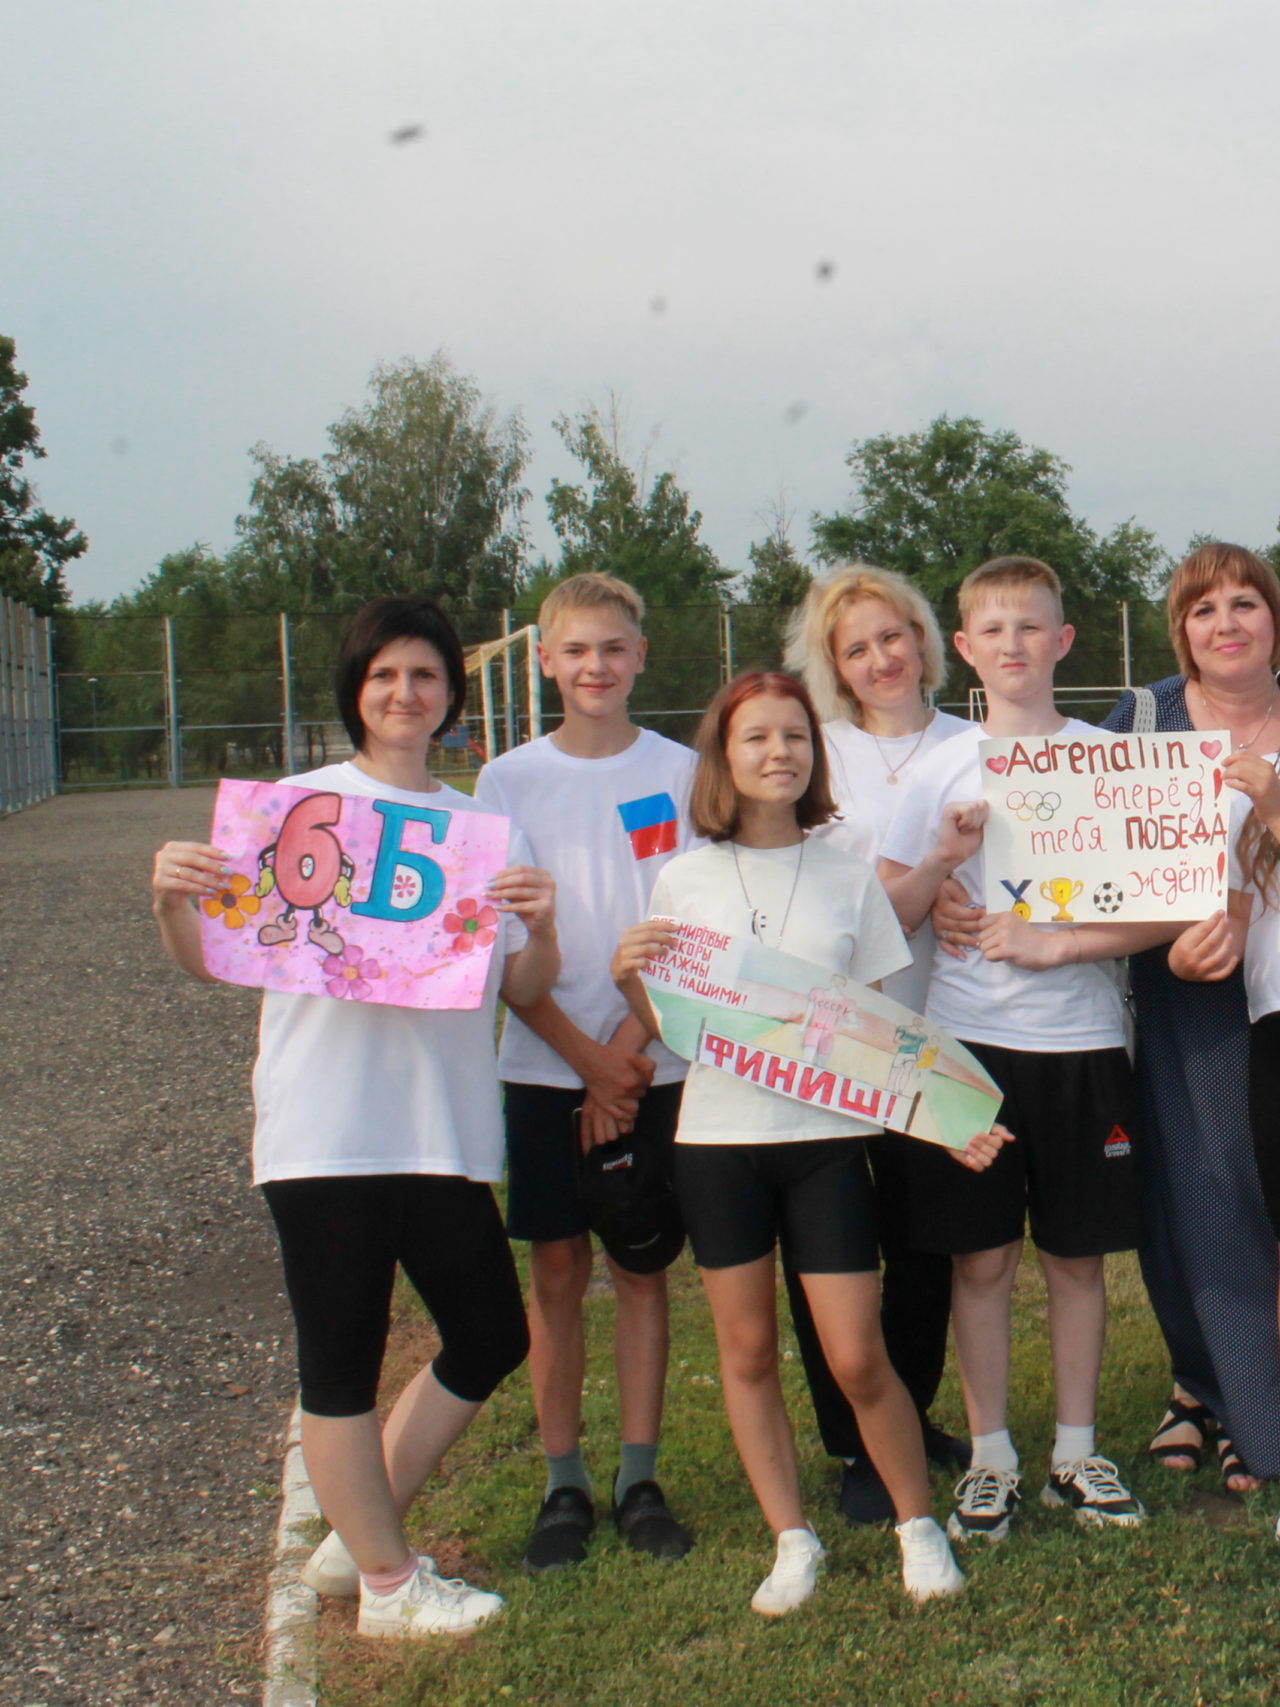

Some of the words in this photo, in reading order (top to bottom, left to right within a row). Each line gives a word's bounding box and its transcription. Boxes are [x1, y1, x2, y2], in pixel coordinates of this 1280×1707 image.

[1094, 768, 1223, 823] вперёд!
[1031, 816, 1108, 855] тебя
[1125, 812, 1228, 850] ПОБЕДА
[1128, 851, 1226, 906] ждёт!
[660, 936, 713, 962] ЕКОРЫ
[678, 974, 749, 1008] НАШИМИ!
[704, 1033, 898, 1126] ФИНИШ!
